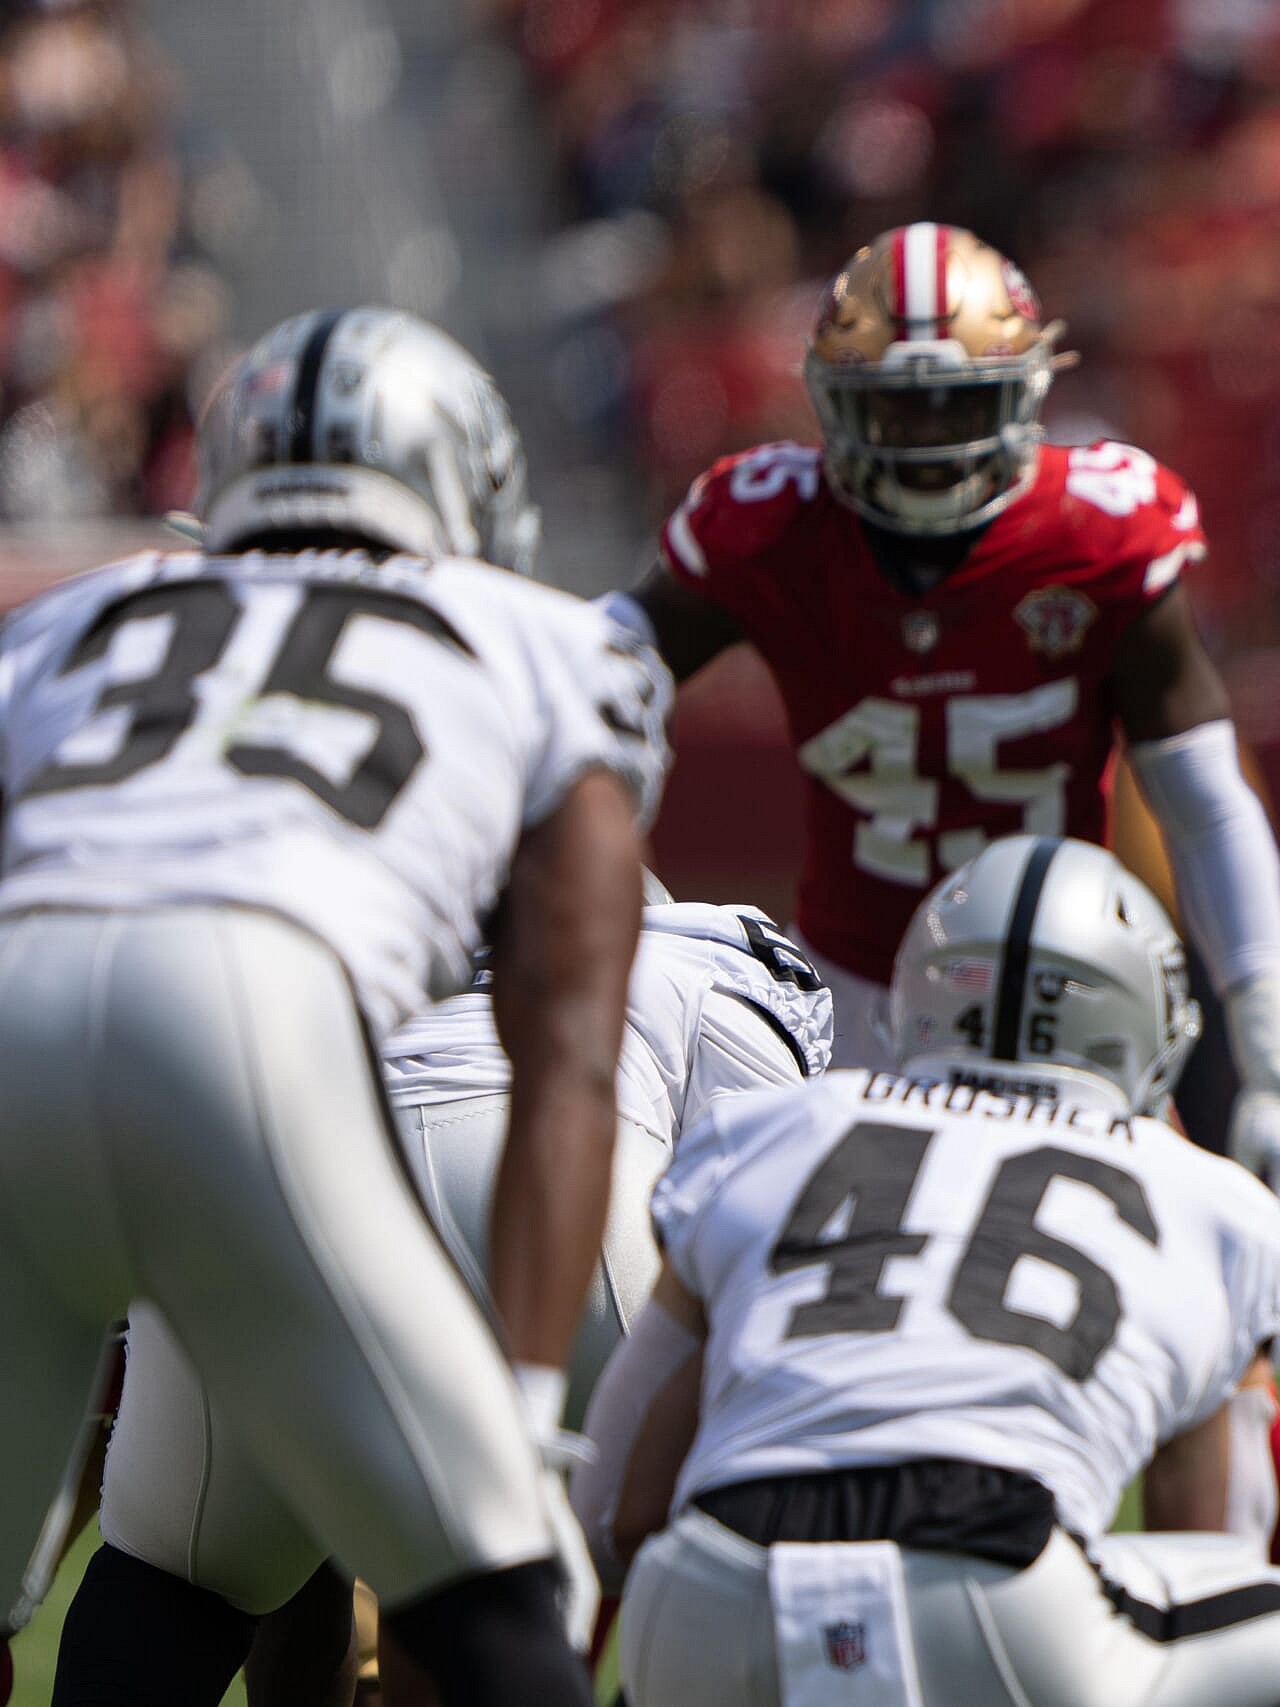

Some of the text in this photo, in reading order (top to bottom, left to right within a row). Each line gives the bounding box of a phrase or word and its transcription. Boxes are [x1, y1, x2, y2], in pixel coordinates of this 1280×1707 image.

[25, 580, 479, 832] 35
[798, 676, 1079, 888] 45
[768, 1121, 1159, 1382] 46
